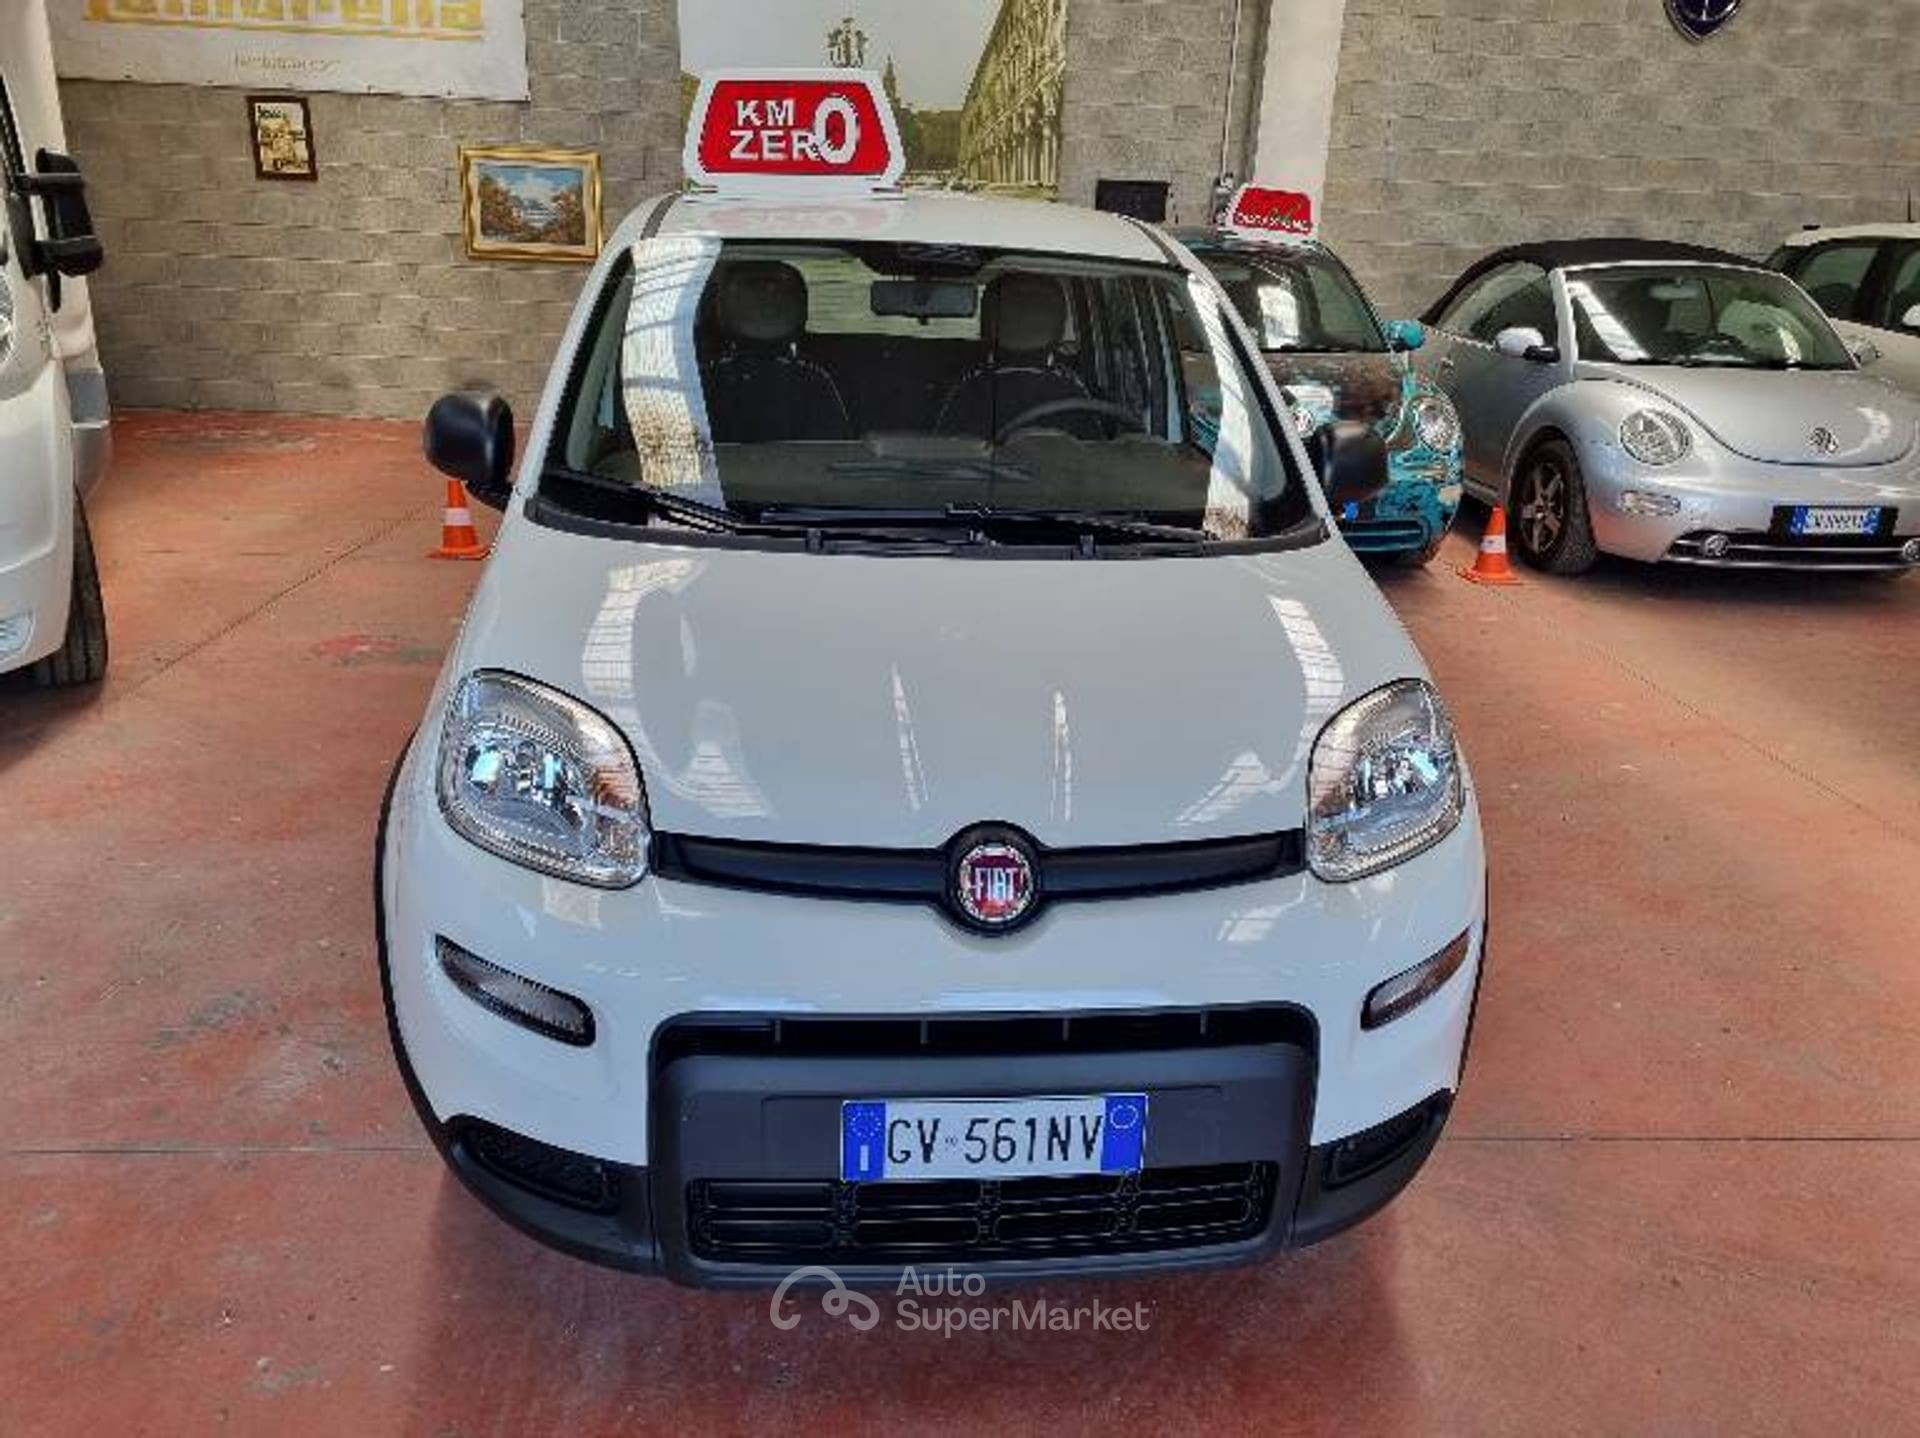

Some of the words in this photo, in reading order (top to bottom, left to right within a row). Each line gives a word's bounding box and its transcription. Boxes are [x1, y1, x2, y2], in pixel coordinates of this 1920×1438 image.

[735, 98, 795, 127] KM
[974, 866, 1019, 901] FIAT
[887, 1118, 941, 1164] GV
[964, 1114, 1103, 1164] 561NV
